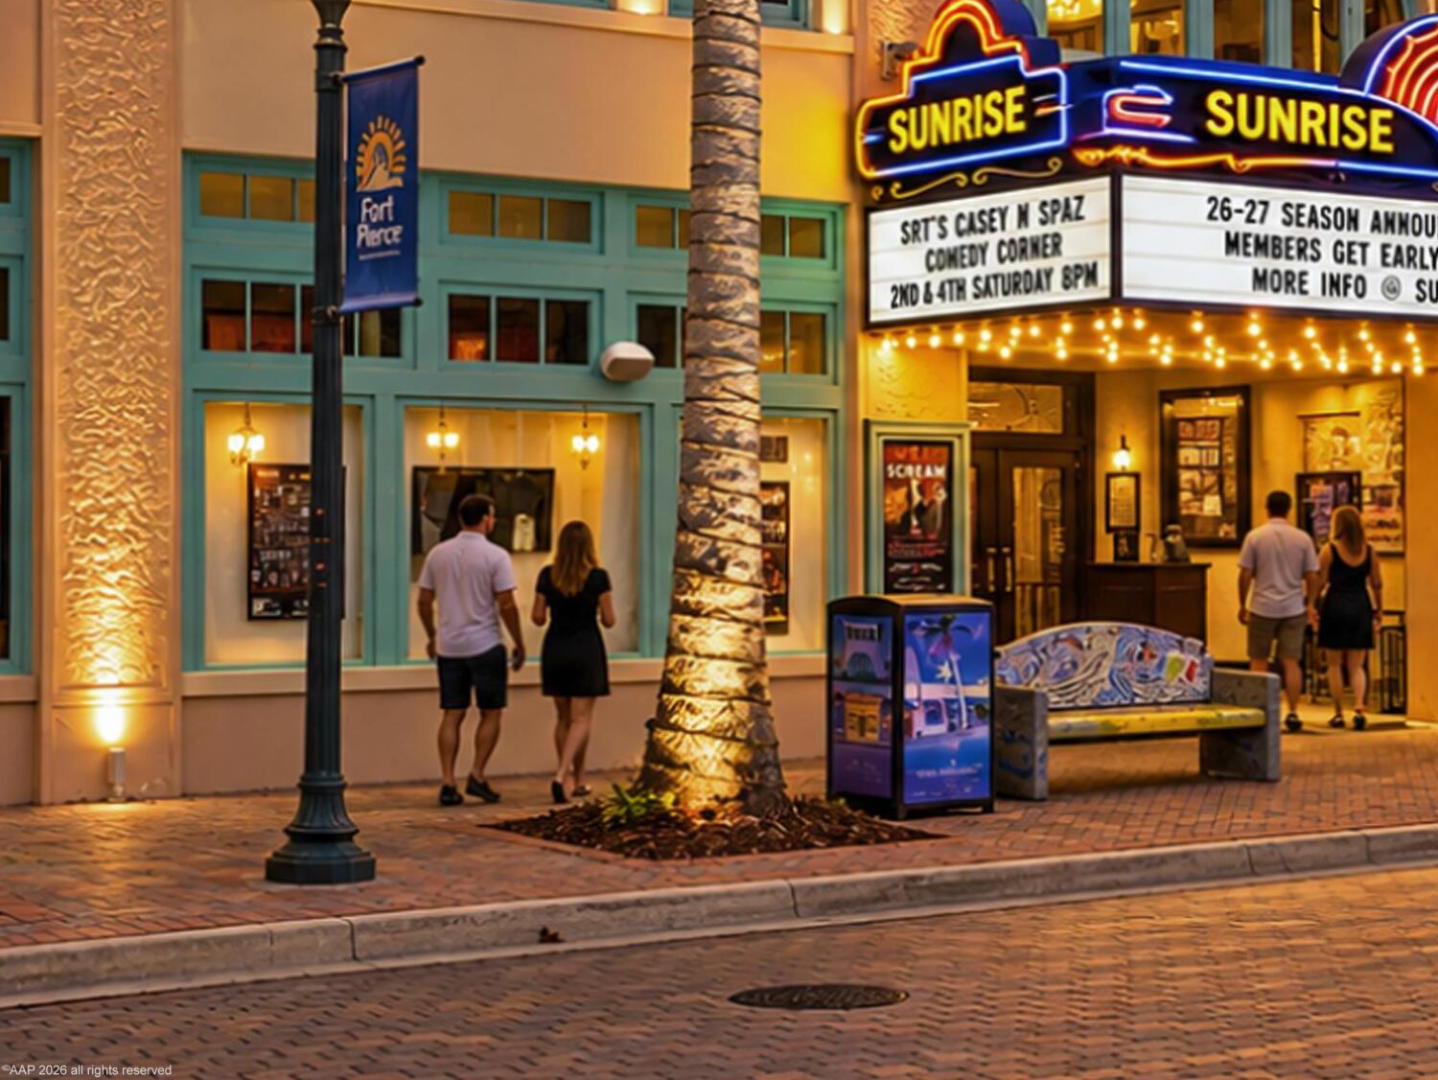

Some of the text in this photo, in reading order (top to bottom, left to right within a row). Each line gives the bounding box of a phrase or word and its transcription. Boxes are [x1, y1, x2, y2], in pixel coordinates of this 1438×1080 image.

[888, 85, 1027, 154] SUNRISE
[1205, 89, 1395, 154] SUNRISE
[361, 195, 394, 223] Fort
[954, 205, 1009, 237] CASEY
[1017, 203, 1030, 229] N
[1038, 195, 1085, 226] SPAZ
[1207, 196, 1270, 225] 26-27
[1281, 202, 1359, 233] SEASON
[357, 224, 403, 249] Pierce
[925, 232, 1063, 273] COMEDY CORNER
[1224, 230, 1321, 262] MEMBERS
[1332, 239, 1369, 266] GET
[890, 261, 1098, 309] 2ND & 4TH SATURDAY 8PM
[1252, 267, 1309, 295] MORE
[1321, 272, 1367, 299] INFO
